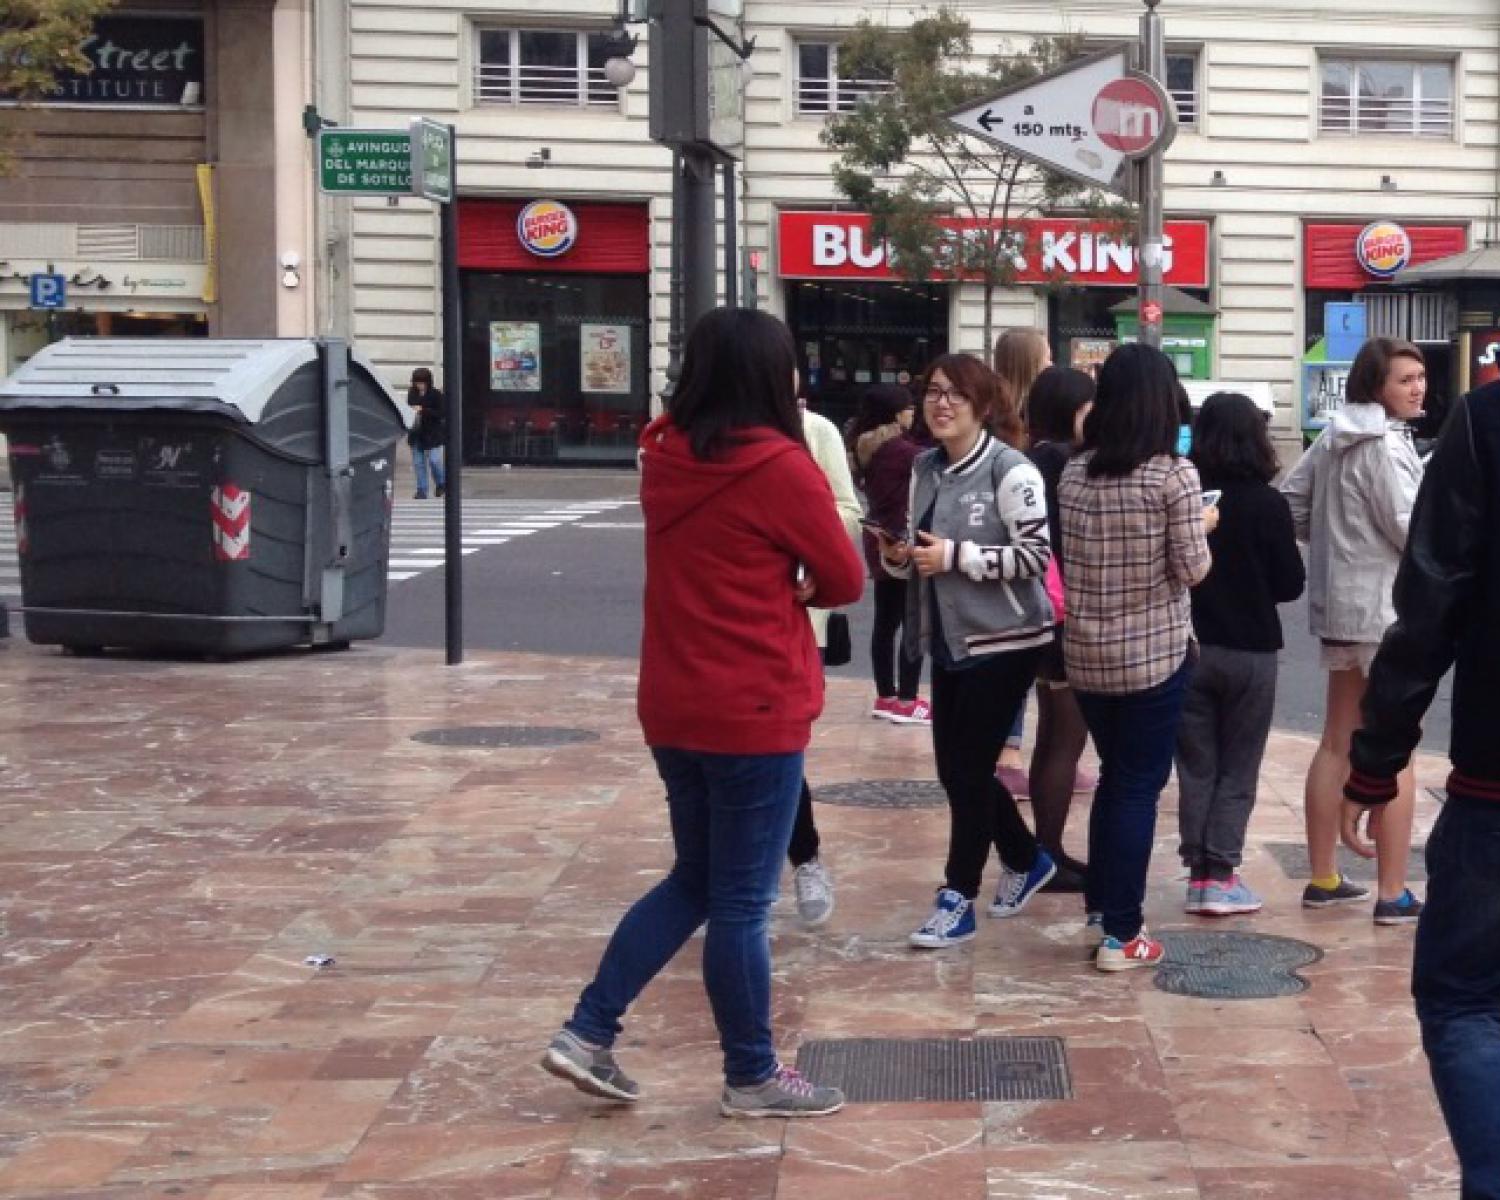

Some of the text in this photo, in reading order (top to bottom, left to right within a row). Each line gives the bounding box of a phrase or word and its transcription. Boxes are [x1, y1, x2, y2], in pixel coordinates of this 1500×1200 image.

[1024, 105, 1035, 115] a
[1014, 124, 1088, 137] 150 mts.
[346, 142, 411, 153] AVINGUD
[325, 159, 411, 171] DEL MARQU
[337, 173, 355, 184] DE
[526, 222, 568, 240] KING
[812, 224, 1028, 272] BUGER
[1365, 244, 1405, 261] KING
[37, 278, 57, 303] P
[967, 503, 985, 527] 2
